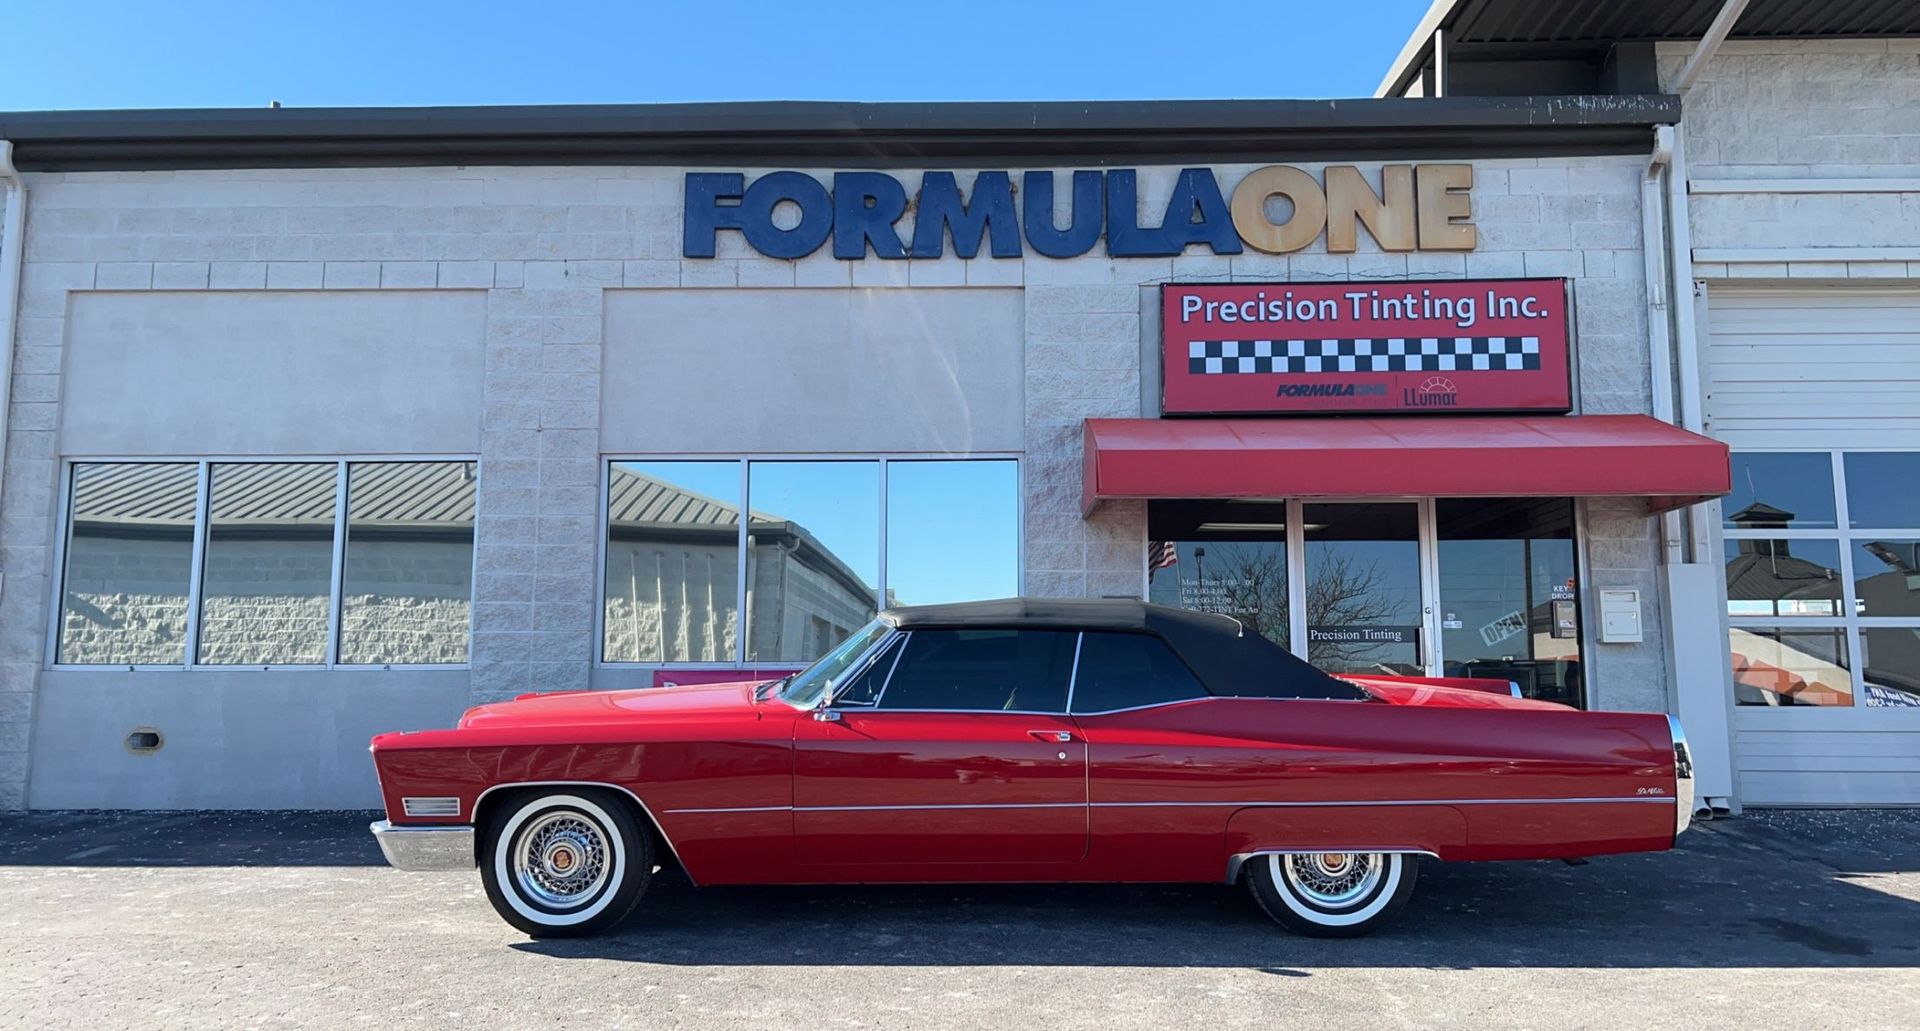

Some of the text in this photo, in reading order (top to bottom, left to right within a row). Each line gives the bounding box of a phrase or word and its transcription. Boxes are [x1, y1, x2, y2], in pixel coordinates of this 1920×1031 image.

[1181, 291, 1549, 327] Precision Tinting Inc.
[1310, 628, 1402, 641] Precision Tinting
[1483, 613, 1525, 645] OPEN
